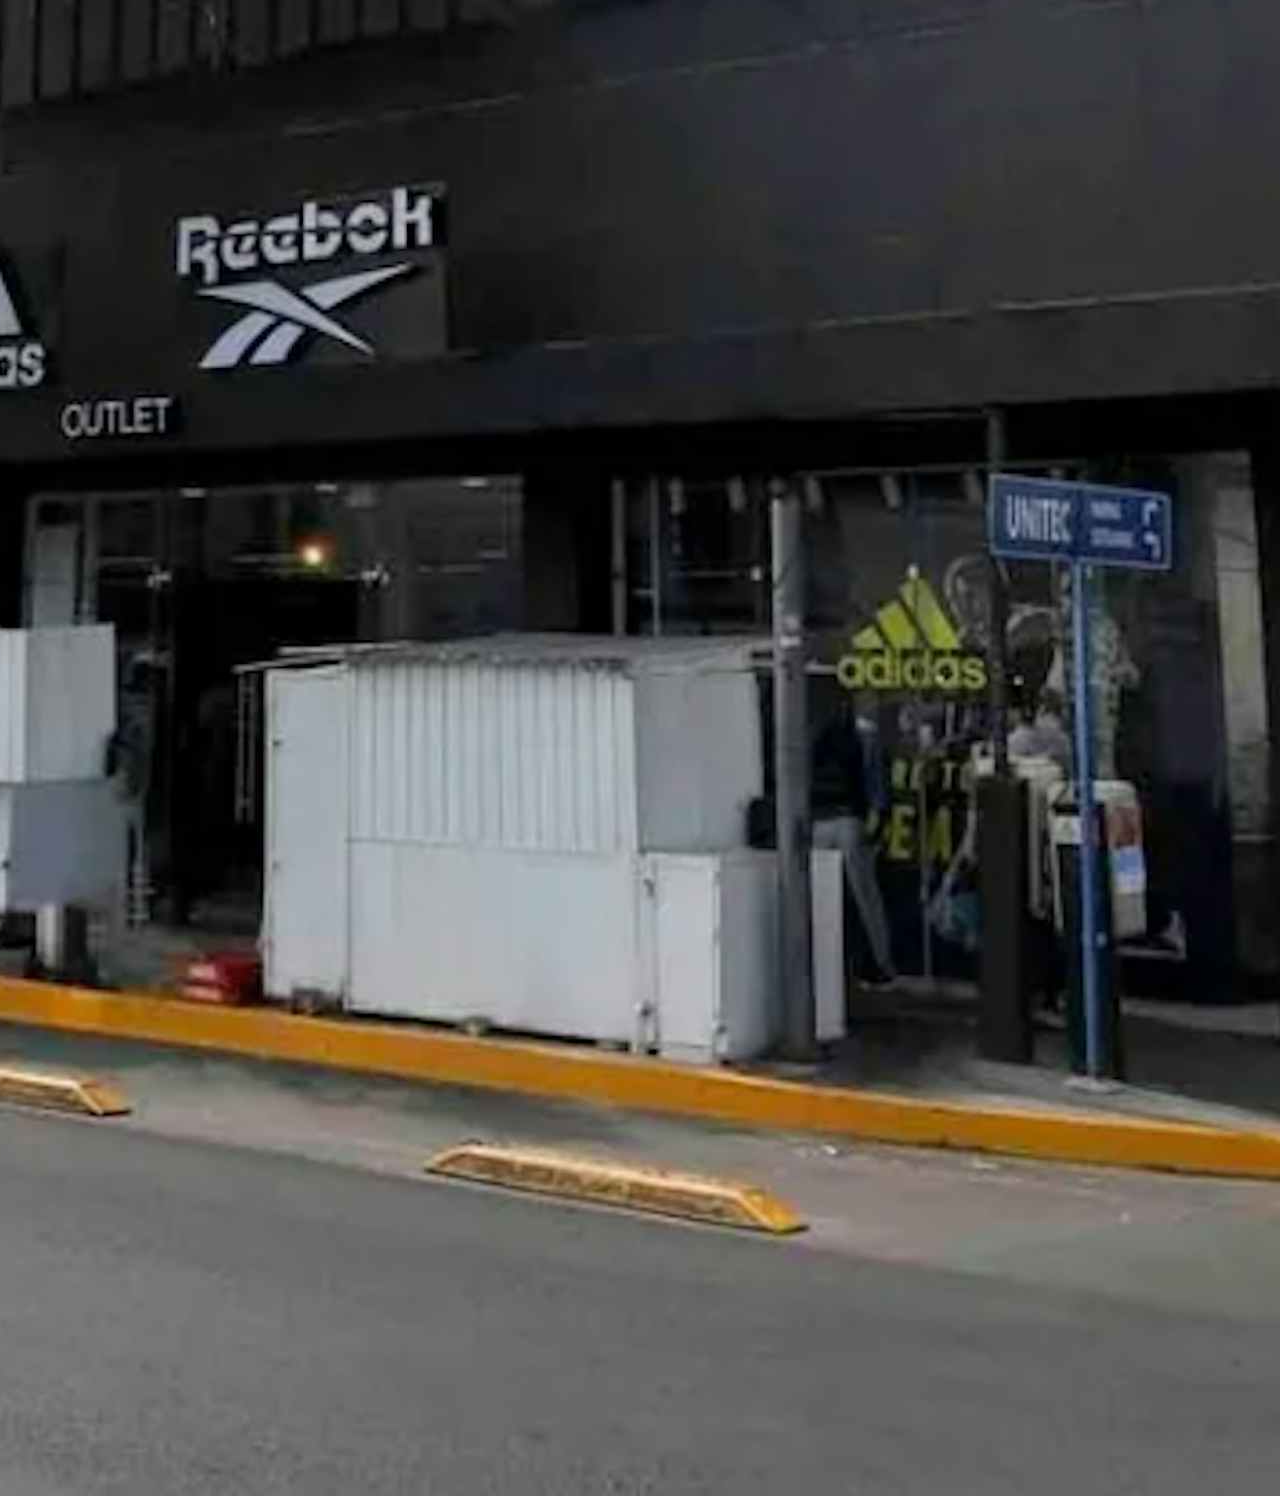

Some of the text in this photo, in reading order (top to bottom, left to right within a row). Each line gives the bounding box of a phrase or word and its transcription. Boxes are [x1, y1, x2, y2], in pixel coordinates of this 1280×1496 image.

[176, 187, 433, 284] Reebok
[61, 397, 172, 438] OUTLET
[1006, 494, 1071, 543] UNITEC
[837, 647, 987, 691] adidas
